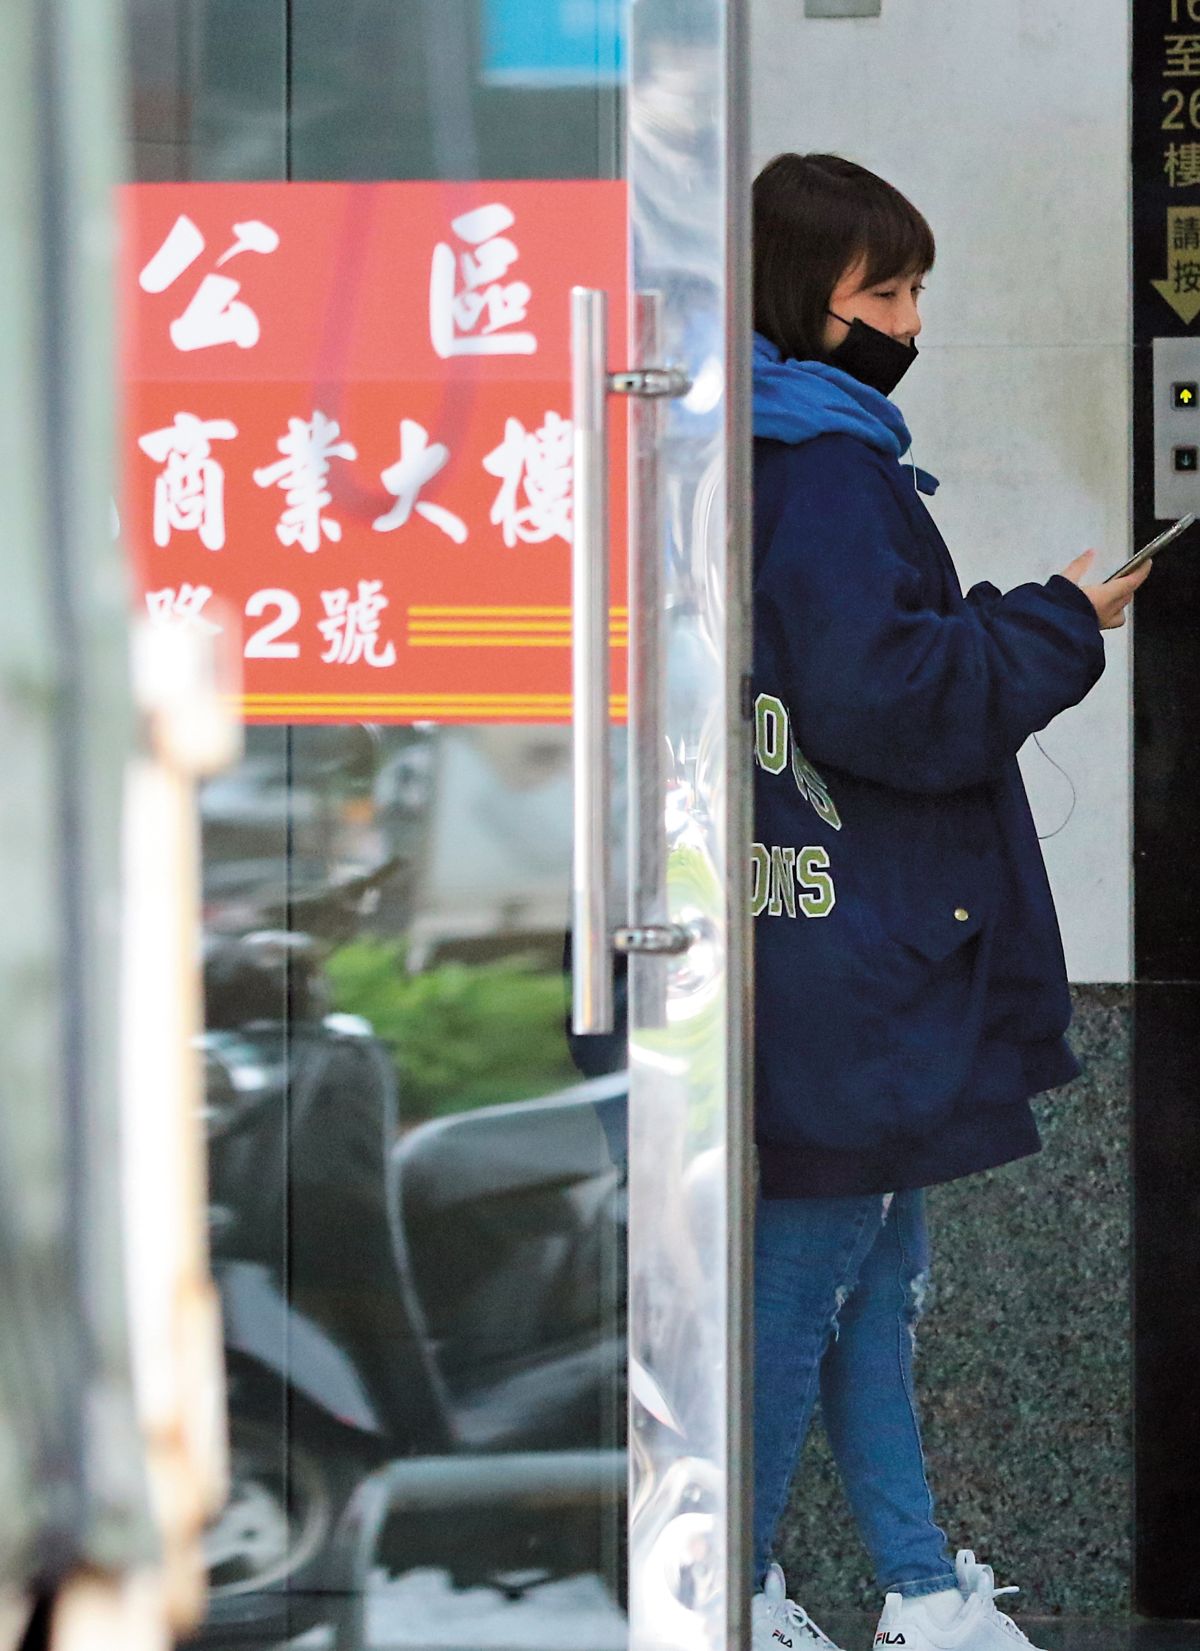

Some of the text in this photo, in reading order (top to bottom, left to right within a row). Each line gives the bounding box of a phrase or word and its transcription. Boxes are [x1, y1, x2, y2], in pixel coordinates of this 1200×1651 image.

[1173, 216, 1200, 293] 請按
[772, 1629, 793, 1648] FILA
[875, 1632, 906, 1645] FILA
